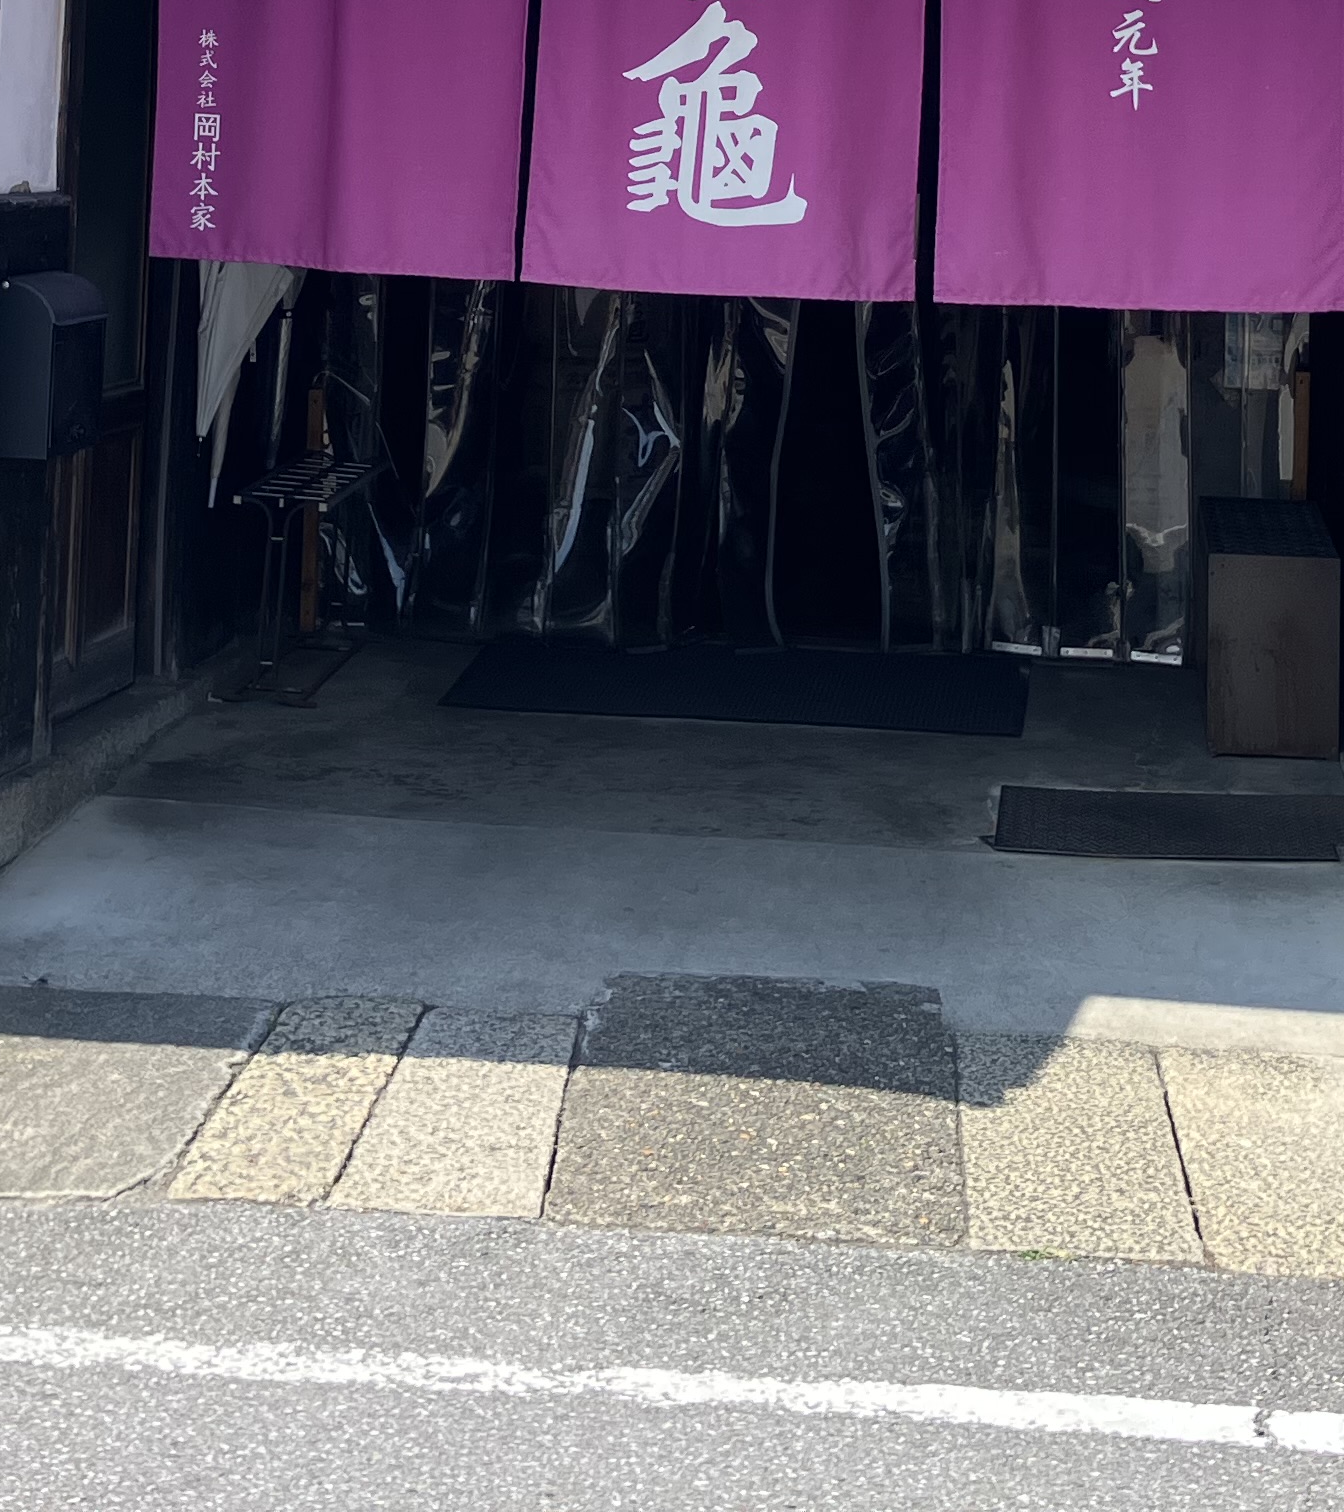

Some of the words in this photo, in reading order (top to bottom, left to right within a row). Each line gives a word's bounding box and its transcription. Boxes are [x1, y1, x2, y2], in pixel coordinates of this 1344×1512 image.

[189, 29, 221, 232] 株式会社岡村本家
